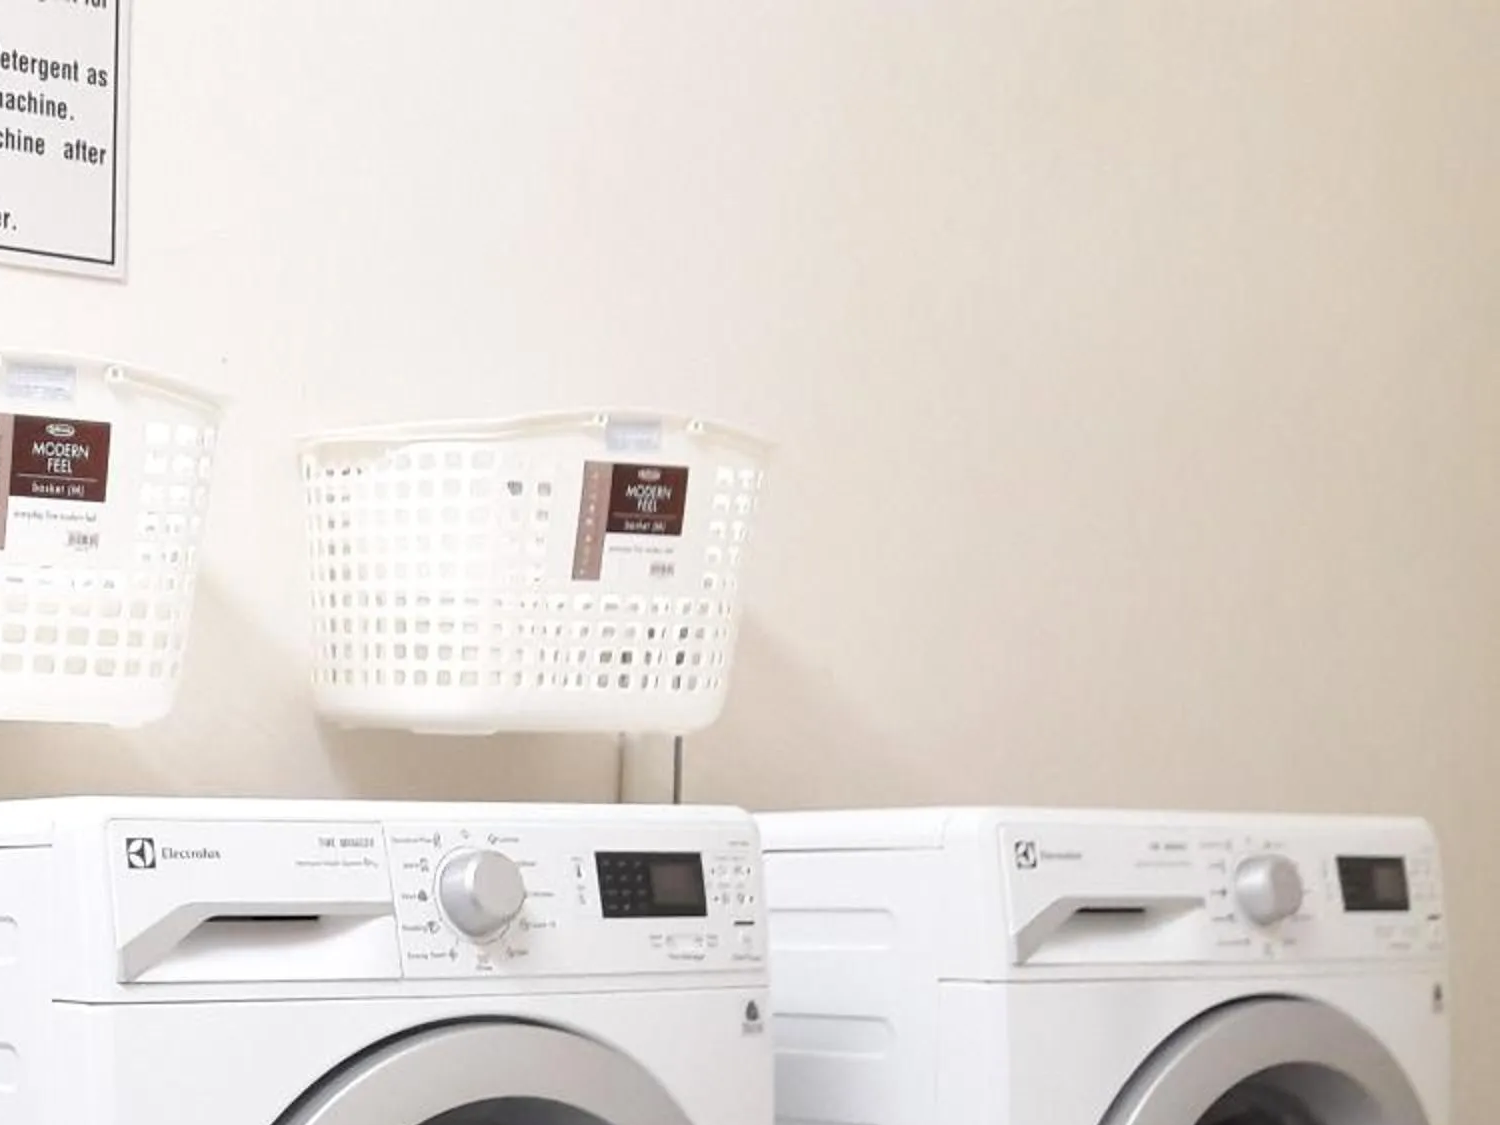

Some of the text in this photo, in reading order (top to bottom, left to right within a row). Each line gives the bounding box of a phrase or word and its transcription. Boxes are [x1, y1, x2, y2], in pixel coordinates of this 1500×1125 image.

[86, 67, 108, 88] as
[63, 139, 107, 166] after
[32, 441, 89, 460] MODERN
[47, 458, 73, 474] FEEL
[161, 847, 221, 860] Electrolux
